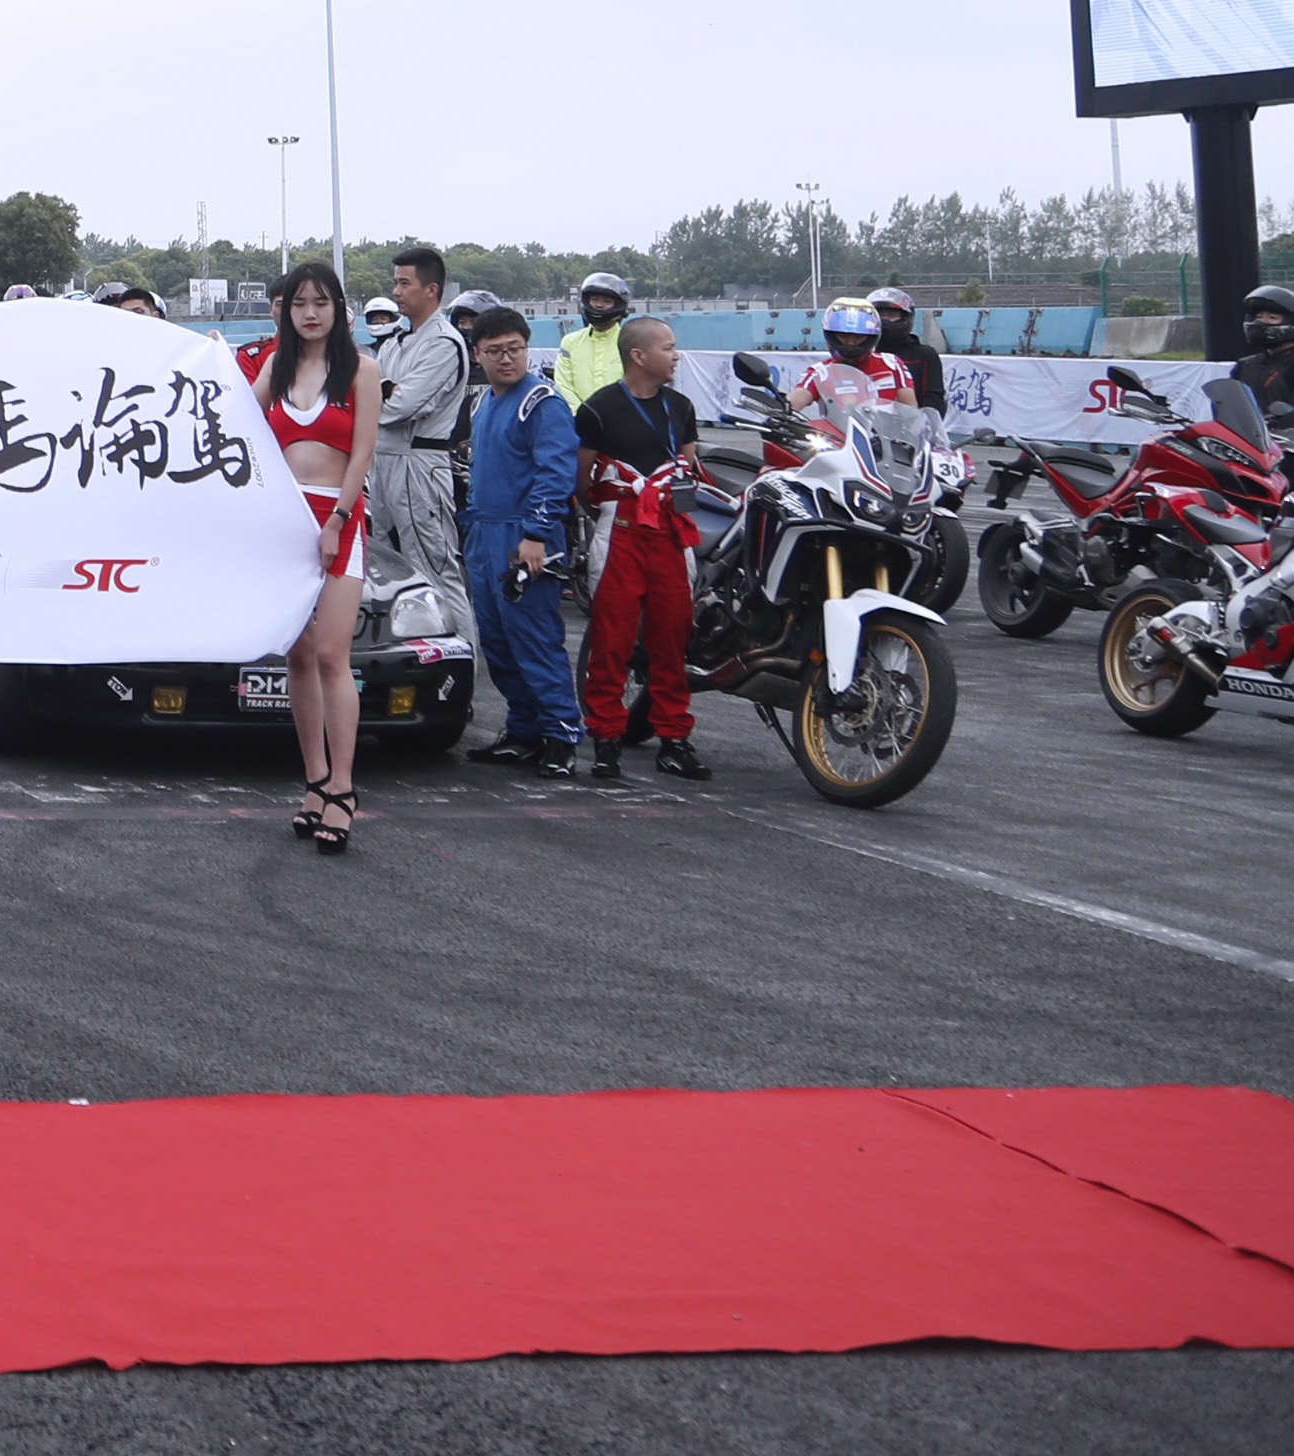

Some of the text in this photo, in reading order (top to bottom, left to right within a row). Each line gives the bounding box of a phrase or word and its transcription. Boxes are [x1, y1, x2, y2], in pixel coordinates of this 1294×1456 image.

[245, 436, 265, 488] since2007
[939, 463, 959, 479] 30
[61, 559, 149, 593] STC
[246, 699, 292, 709] TRACK RAC
